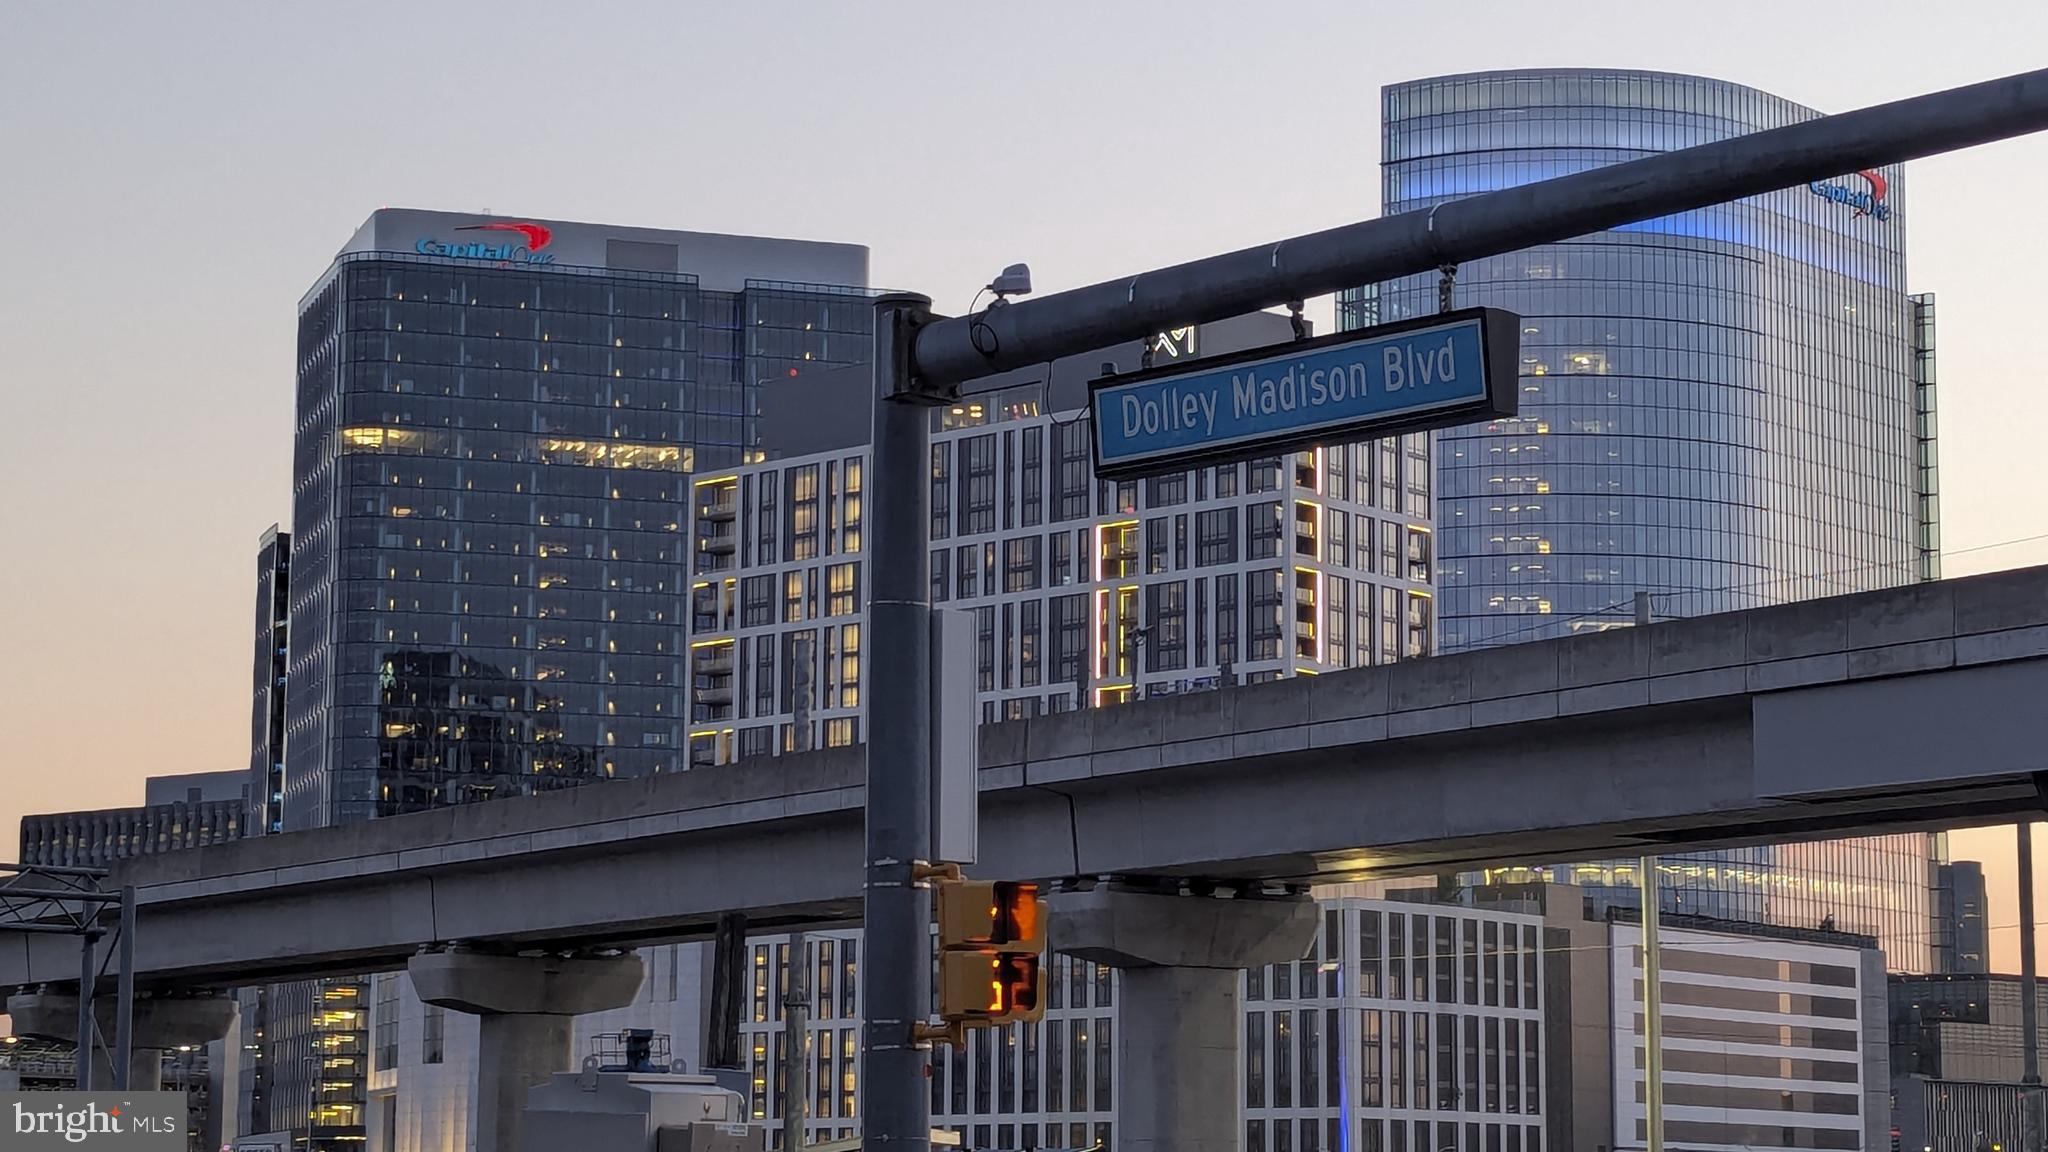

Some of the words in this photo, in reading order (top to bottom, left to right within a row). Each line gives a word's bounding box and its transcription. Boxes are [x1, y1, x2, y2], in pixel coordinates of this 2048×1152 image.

[1122, 387, 1218, 437] Dolley
[1232, 361, 1367, 419] Madison
[1383, 337, 1456, 392] Blvd
